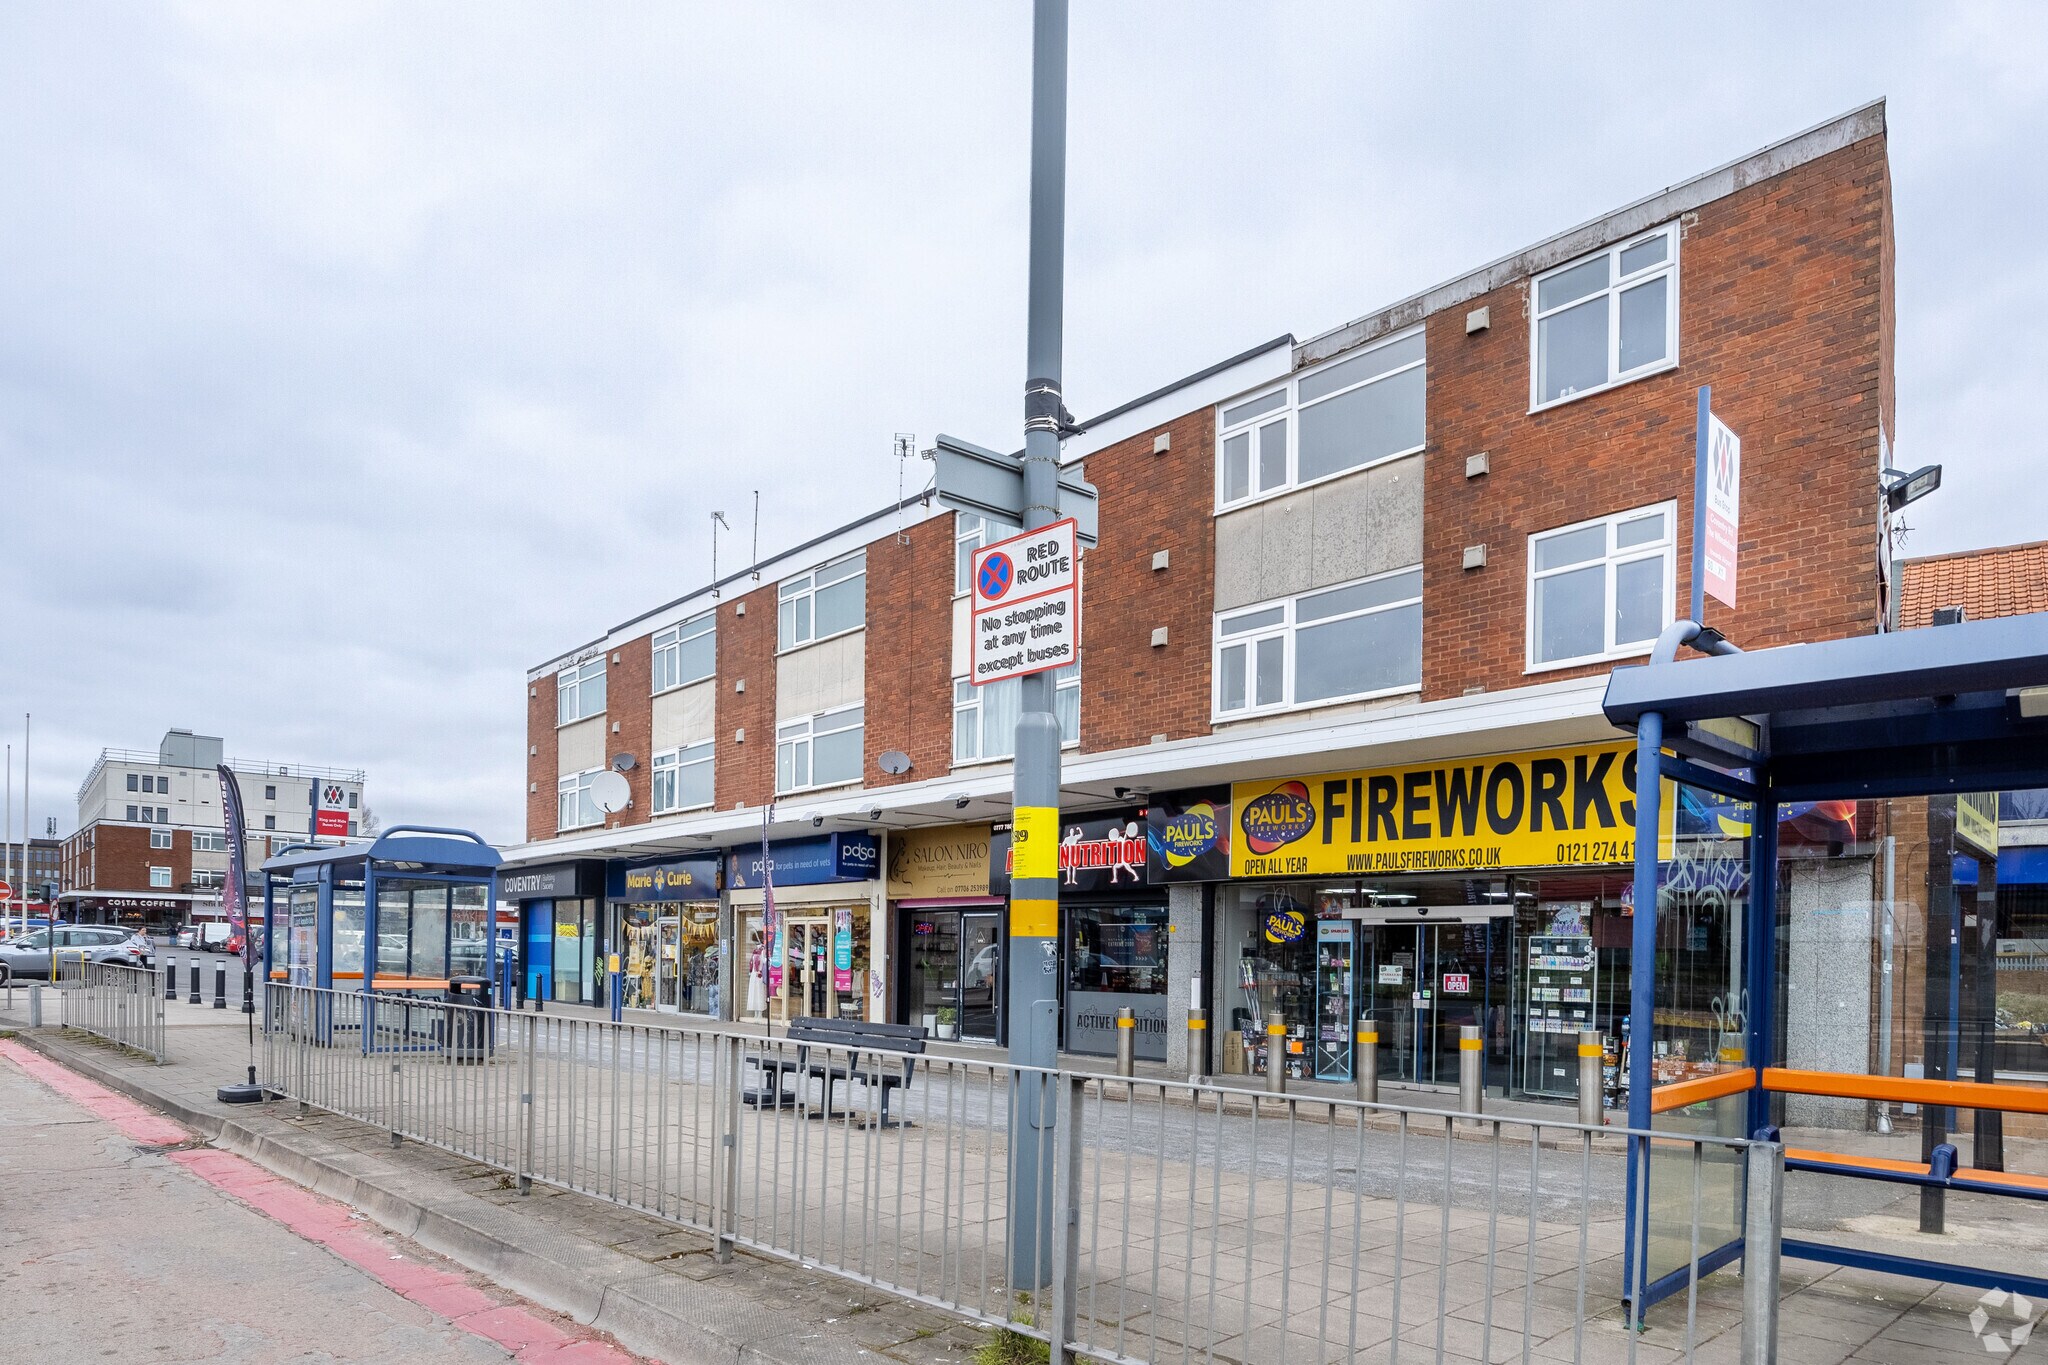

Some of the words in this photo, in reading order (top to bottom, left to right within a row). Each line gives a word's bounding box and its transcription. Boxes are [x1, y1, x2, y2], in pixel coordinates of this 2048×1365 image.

[1027, 540, 1059, 563] RED
[1017, 556, 1070, 585] ROUTE
[982, 617, 1001, 632] No
[1004, 601, 1066, 626] stopping
[984, 635, 999, 651] at
[1002, 630, 1027, 646] any
[1030, 621, 1063, 639] time
[978, 652, 1024, 674] except
[1027, 643, 1070, 663] buses
[1322, 748, 1637, 845] FIREWORKS
[1249, 803, 1307, 825] PAULS
[1166, 822, 1214, 842] PAULS
[1251, 824, 1305, 833] FIREWORKS
[843, 842, 876, 861] pdsa
[913, 845, 953, 864] SALON
[957, 842, 988, 860] NIRO
[1059, 839, 1147, 868] NUTRITION
[1174, 839, 1203, 848] FIREWORKS
[1557, 843, 1588, 862] 0121
[1592, 841, 1617, 861] 274
[752, 857, 775, 877] pda
[783, 862, 794, 872] pets
[795, 861, 800, 869] in
[800, 860, 813, 868] need
[813, 859, 819, 867] of
[820, 858, 831, 866] vets
[1245, 859, 1266, 875] OPEN
[1268, 858, 1283, 873] ALL
[1286, 857, 1308, 873] YEAR
[1347, 847, 1501, 871] WWW.PAULSFIREWORKS.CO.UK
[505, 875, 541, 893] COVENTRY
[627, 874, 652, 889] Marie
[667, 870, 692, 887] Curie
[937, 885, 947, 894] Call
[107, 899, 138, 907] COSTA
[140, 900, 177, 908] COFFEE
[1269, 915, 1302, 936] PAULS
[1447, 982, 1466, 990] OPEN
[1077, 1015, 1111, 1029] ACTIVE
[1113, 1016, 1168, 1034] NRITION
